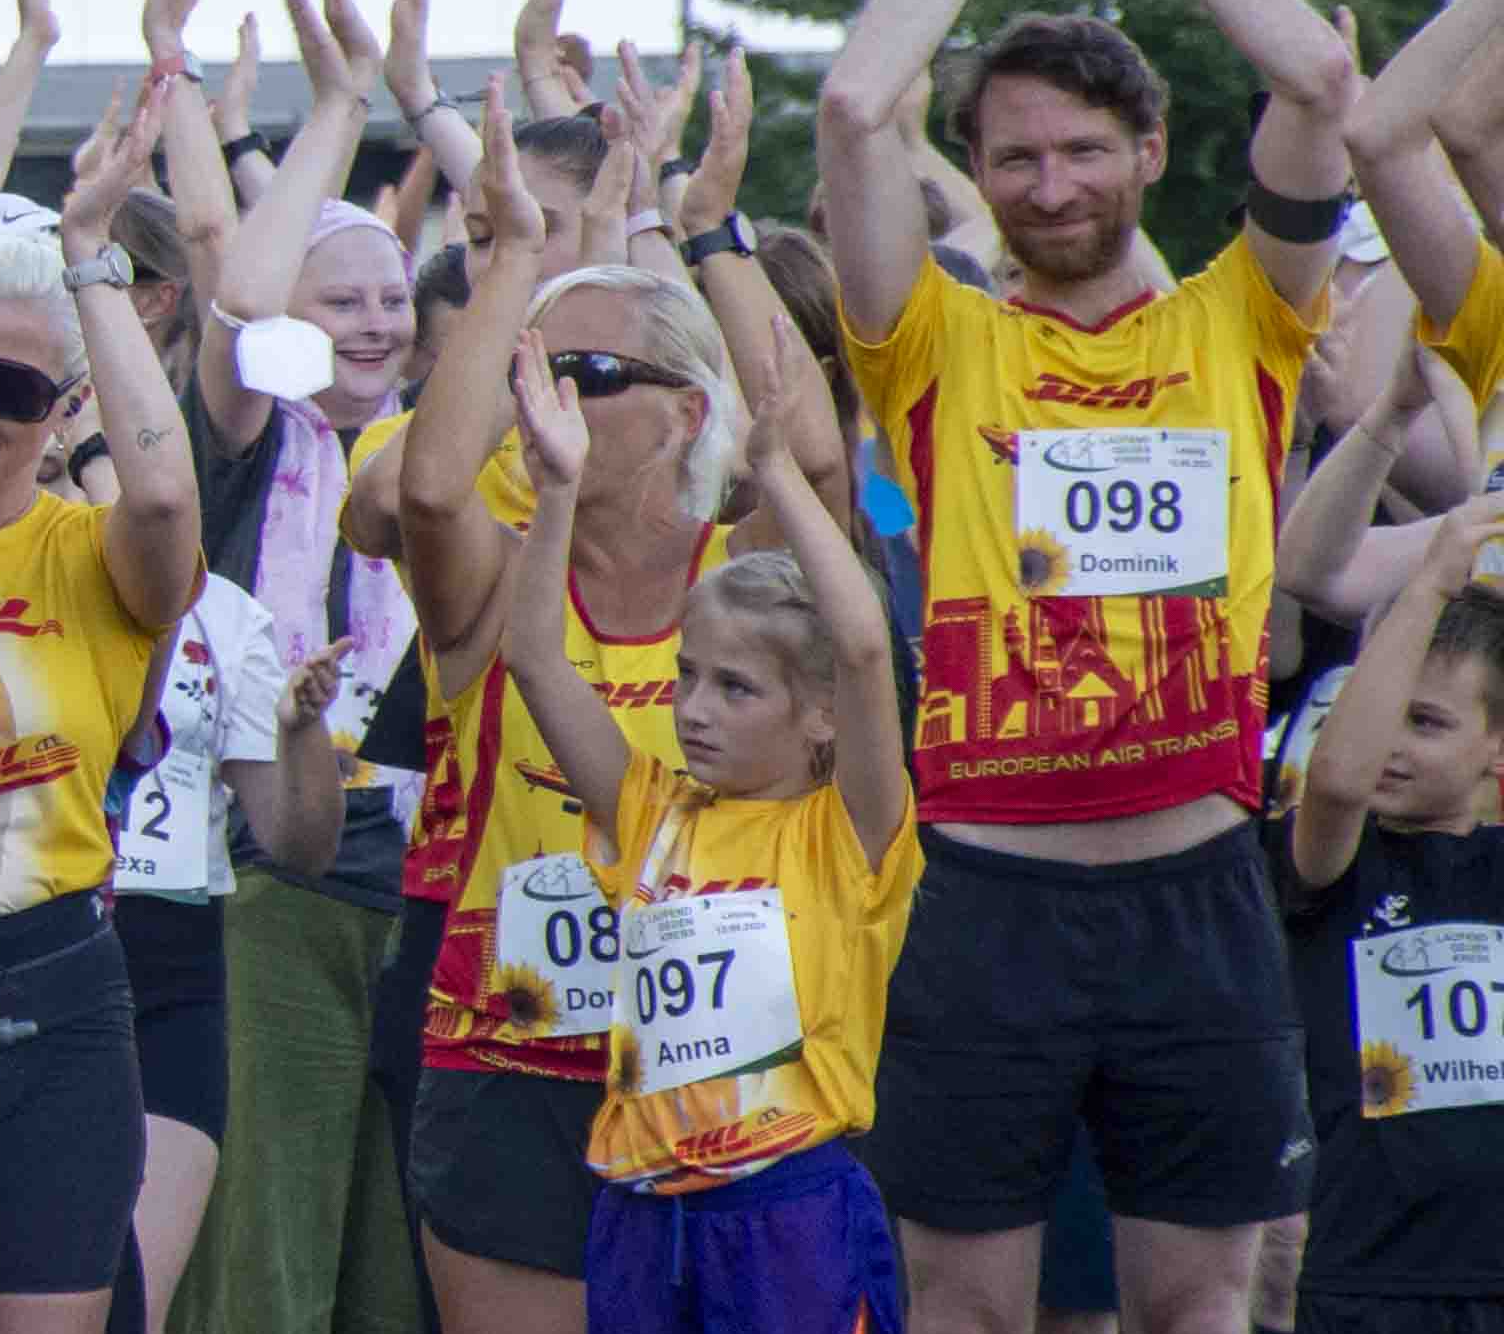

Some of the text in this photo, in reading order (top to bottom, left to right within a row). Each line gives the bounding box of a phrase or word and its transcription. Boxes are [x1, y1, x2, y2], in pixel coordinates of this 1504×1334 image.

[1066, 480, 1184, 534] 098
[1080, 554, 1180, 574] Dominik
[949, 720, 1240, 779] EUROPEAN AIR TRANS
[545, 905, 620, 967] 08
[637, 948, 736, 1025] 097
[658, 1035, 731, 1065] Anna
[1423, 1059, 1504, 1084] Wilhel
